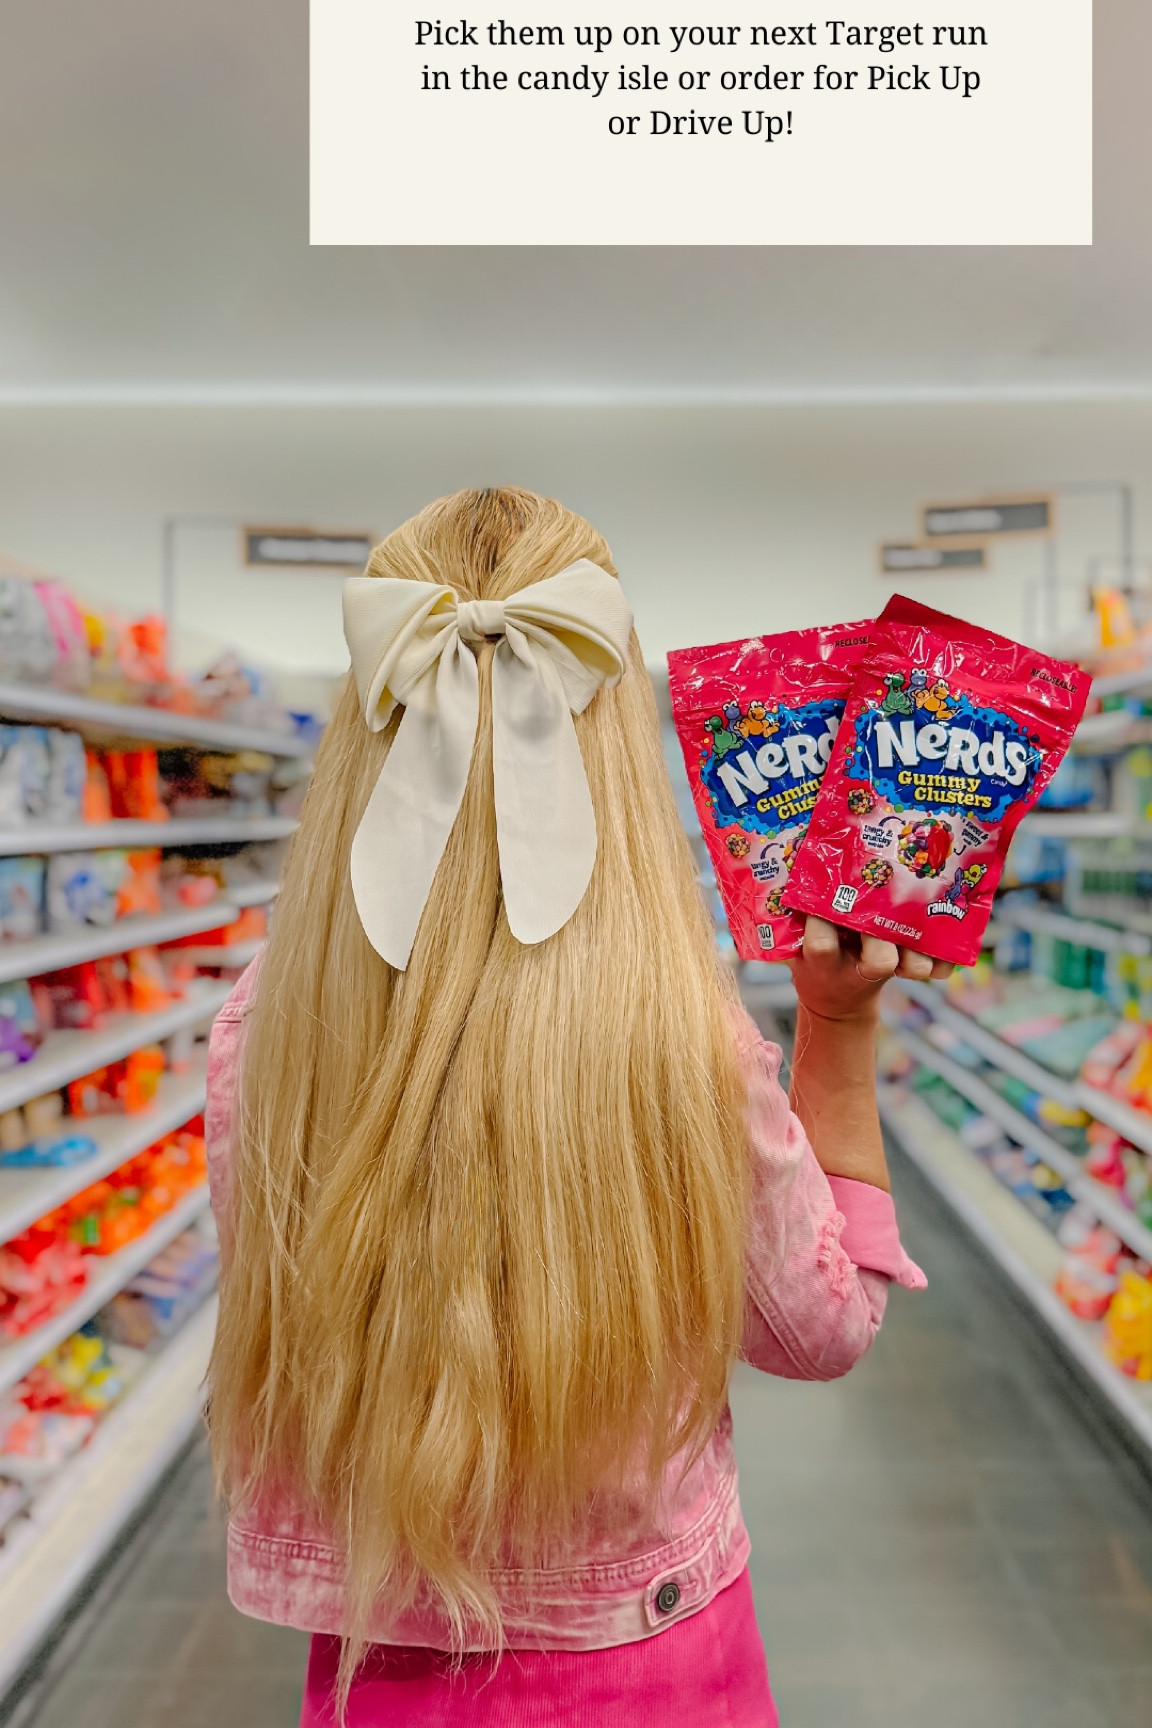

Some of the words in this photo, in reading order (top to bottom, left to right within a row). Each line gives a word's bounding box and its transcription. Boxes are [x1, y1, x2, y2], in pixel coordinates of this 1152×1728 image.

[898, 771, 982, 793] Gummy
[756, 777, 825, 812] Gumm
[914, 787, 993, 809] Clusters
[839, 886, 856, 902] 100
[927, 899, 966, 920] rainbow
